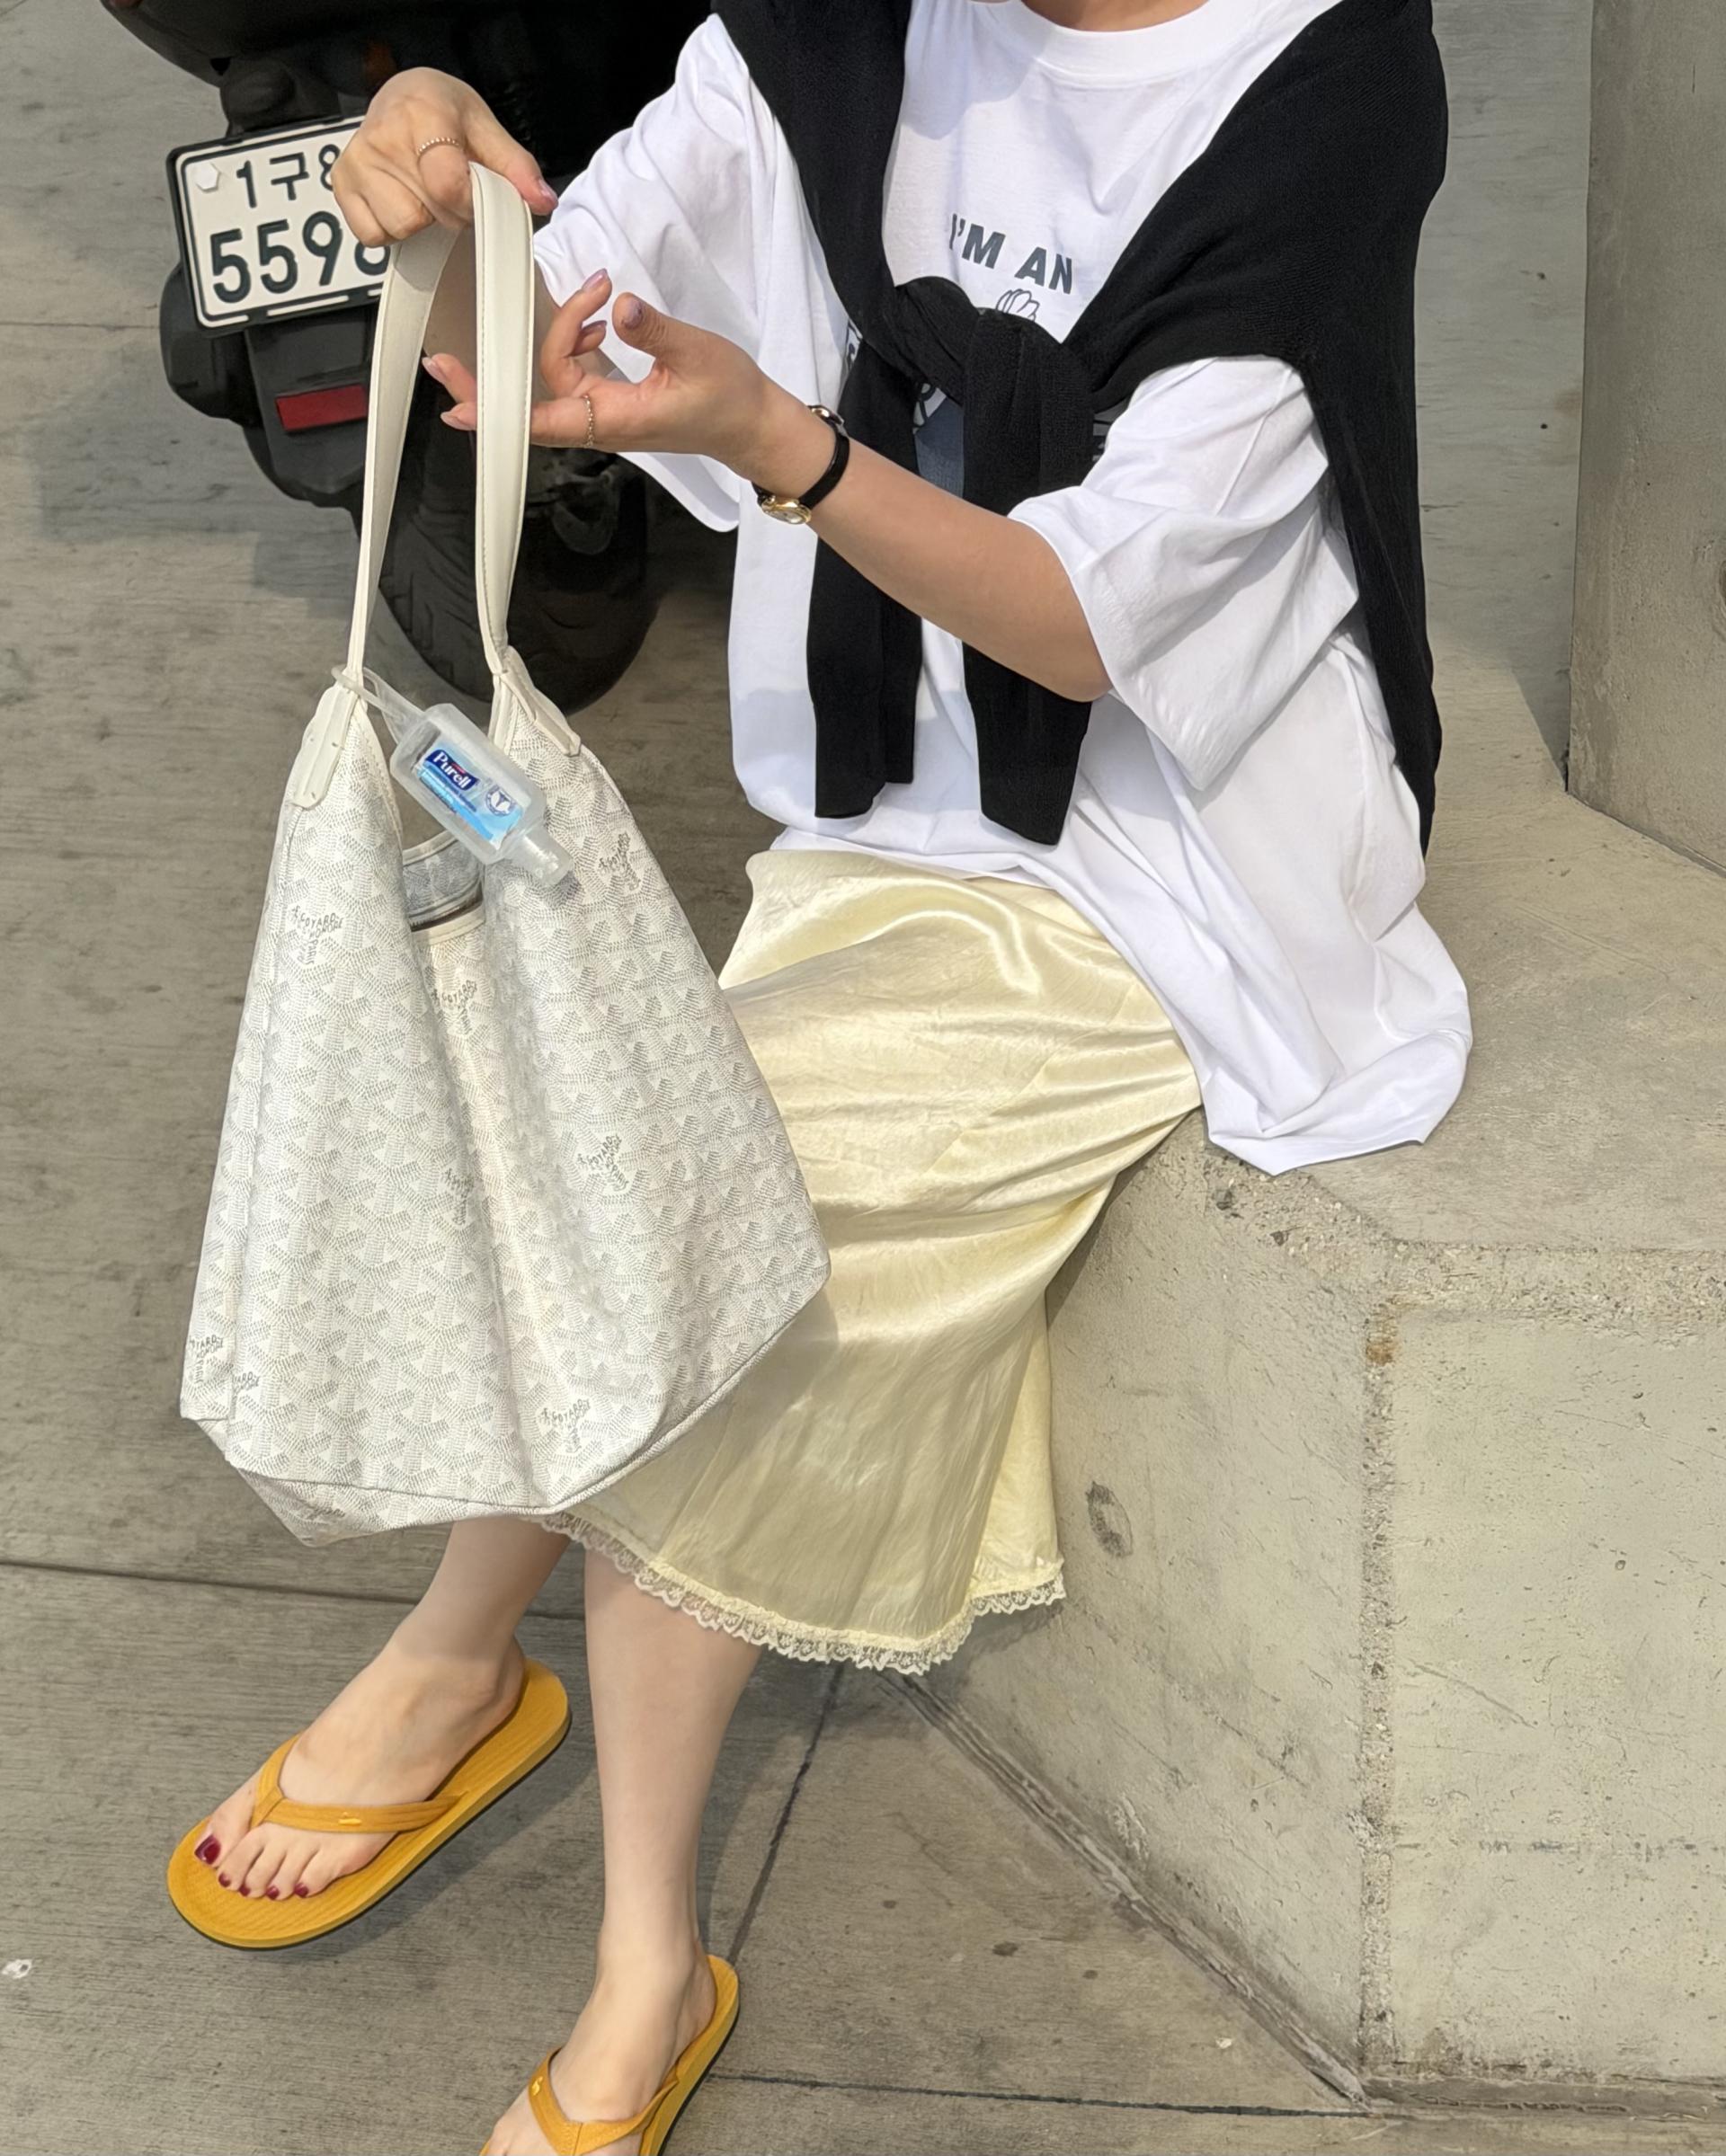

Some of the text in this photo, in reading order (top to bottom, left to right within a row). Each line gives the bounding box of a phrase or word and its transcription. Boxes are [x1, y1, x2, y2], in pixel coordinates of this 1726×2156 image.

[948, 213, 1072, 295] I'M AN
[432, 751, 472, 789] Purell
